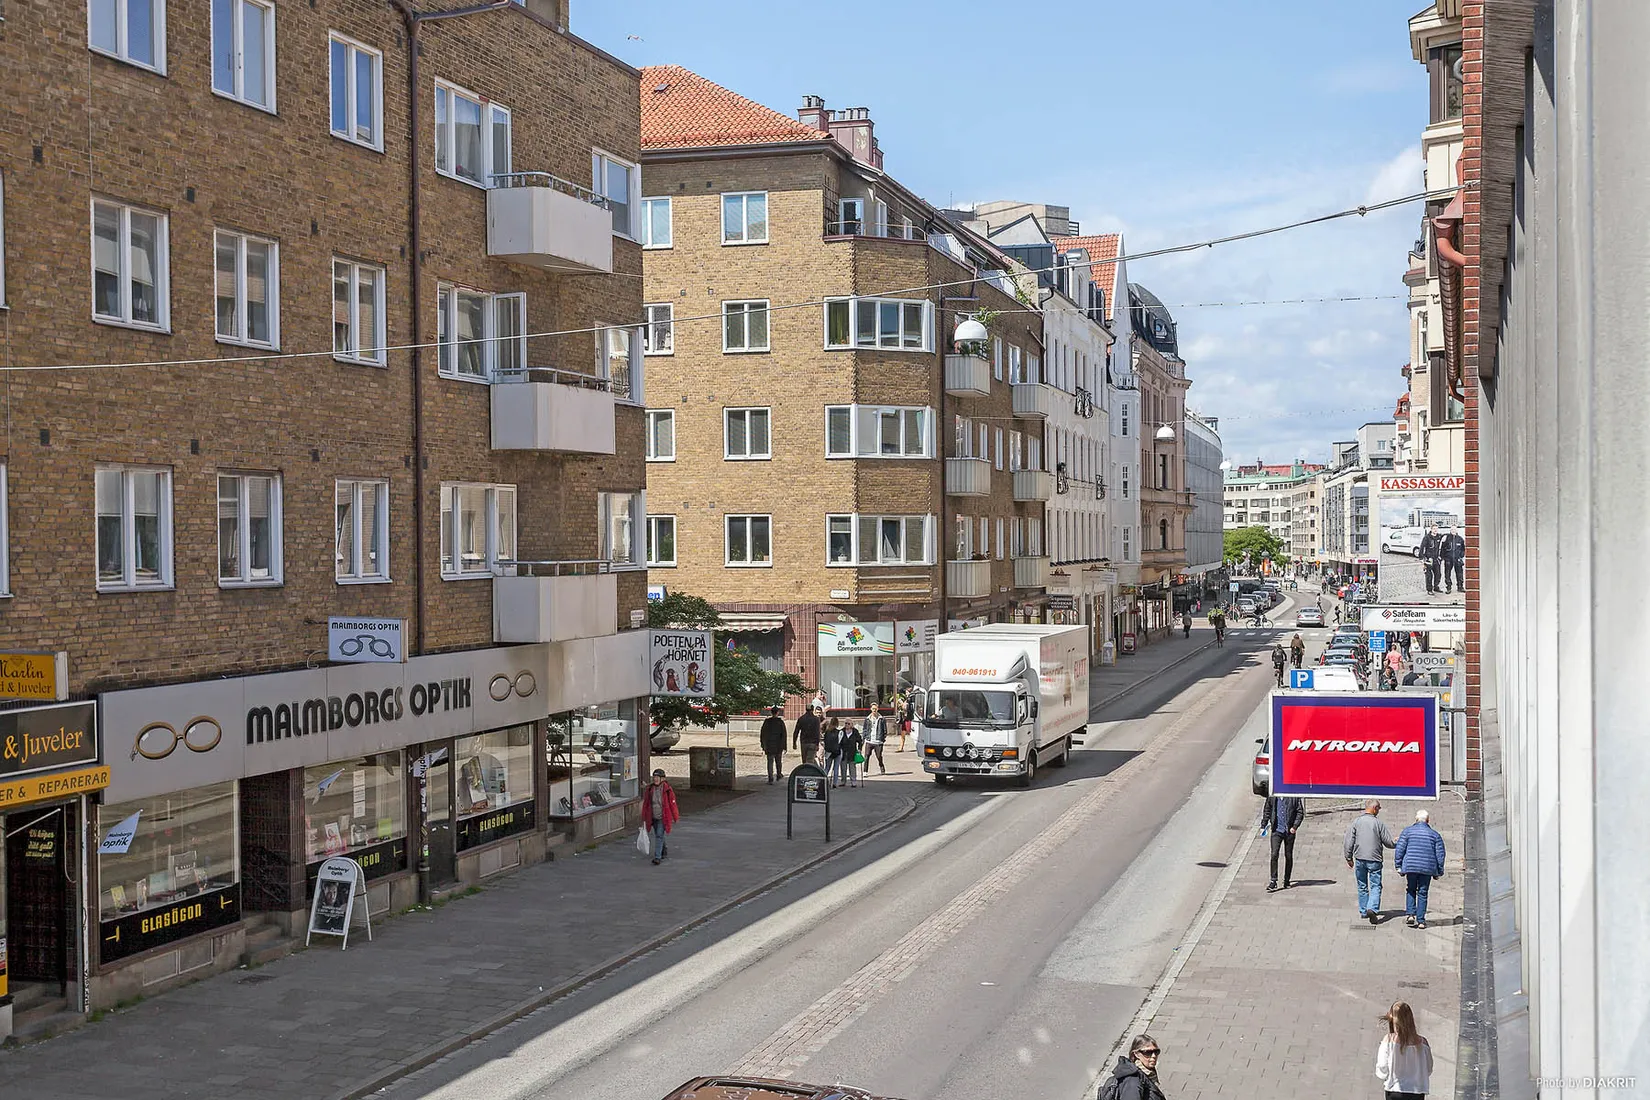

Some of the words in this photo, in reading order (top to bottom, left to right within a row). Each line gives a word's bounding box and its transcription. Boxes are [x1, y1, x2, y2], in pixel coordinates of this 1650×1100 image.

[1381, 477, 1465, 489] KASSASKAP
[1392, 609, 1426, 618] SafeTeam
[331, 622, 376, 631] MALMBORGS
[377, 622, 400, 632] OPTIK
[654, 634, 692, 648] POETEN
[695, 633, 707, 649] PÅ
[668, 648, 707, 662] HÖRNET
[952, 668, 997, 677] 040-961913
[1296, 671, 1309, 688] P
[7, 682, 14, 693] &
[16, 681, 52, 696] Juveler
[246, 685, 404, 745] MALMBORGS
[409, 676, 471, 717] OPTIK
[4, 735, 19, 760] &
[22, 726, 83, 764] Juveler
[1287, 739, 1421, 754] MYRORNA
[18, 786, 26, 798] &
[38, 771, 107, 795] REPARERAR
[479, 812, 514, 832] GLASÖGON
[103, 837, 129, 849] optik
[141, 903, 202, 934] GLASÖGON
